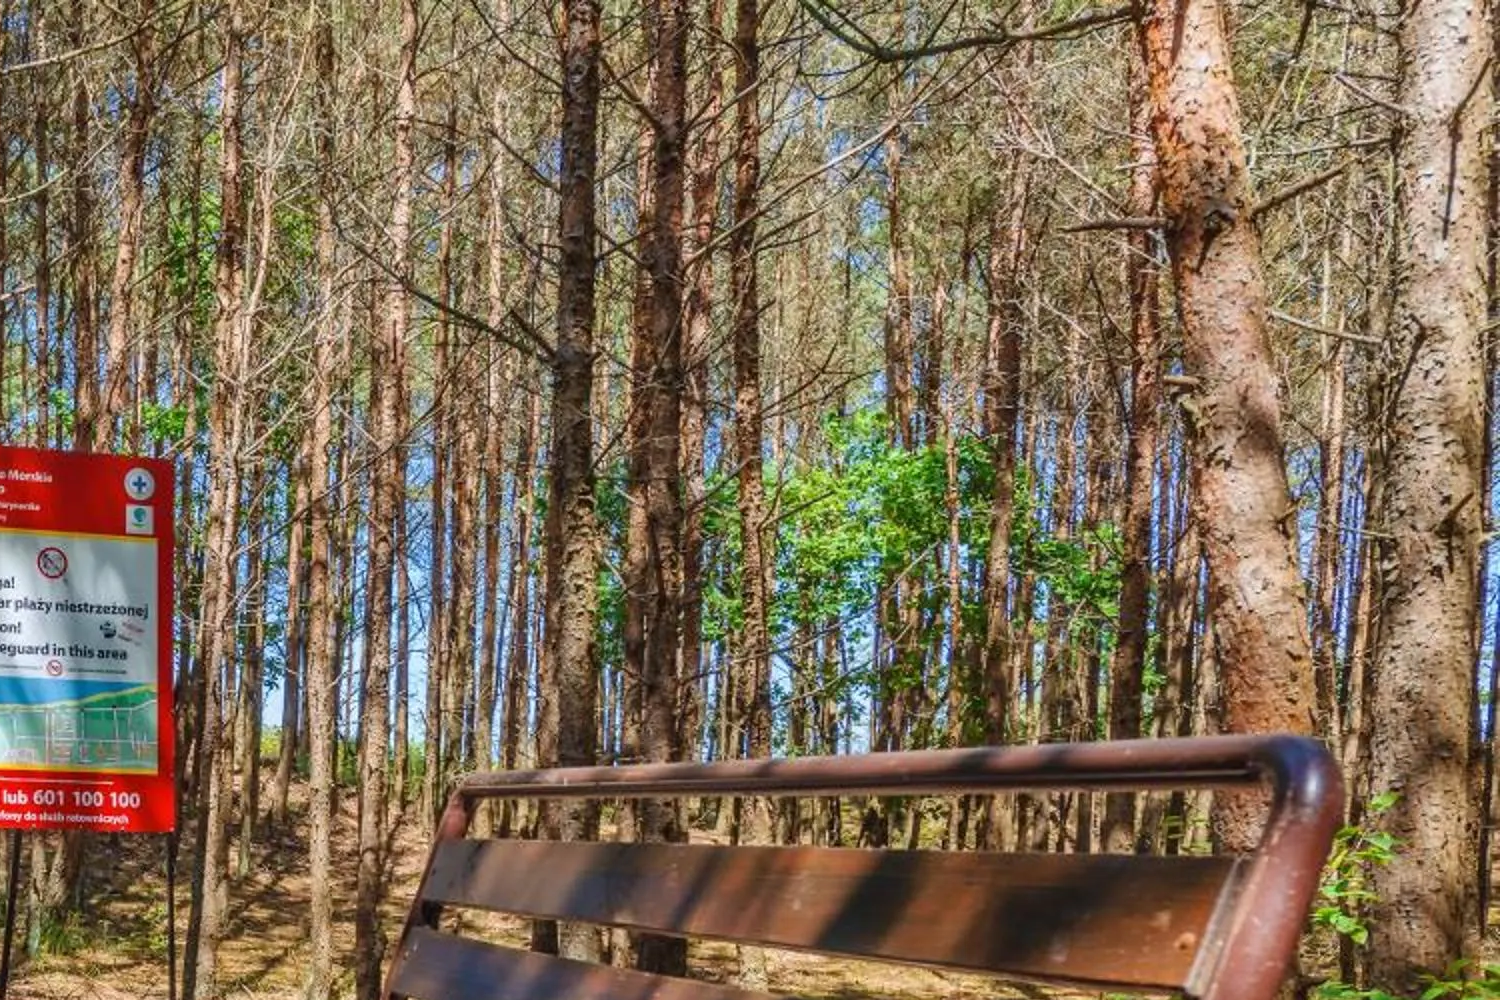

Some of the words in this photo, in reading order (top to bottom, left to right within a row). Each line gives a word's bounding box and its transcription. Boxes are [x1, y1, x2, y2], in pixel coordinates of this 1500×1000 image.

[8, 469, 53, 483] Morskie
[15, 597, 53, 614] plaży
[55, 600, 149, 620] niestrzeżonej
[52, 643, 66, 657] in
[69, 644, 94, 658] this
[96, 649, 128, 660] area
[3, 791, 28, 805] lub
[33, 790, 65, 806] 601
[73, 792, 104, 807] 100
[110, 793, 141, 808] 100
[24, 811, 37, 821] do
